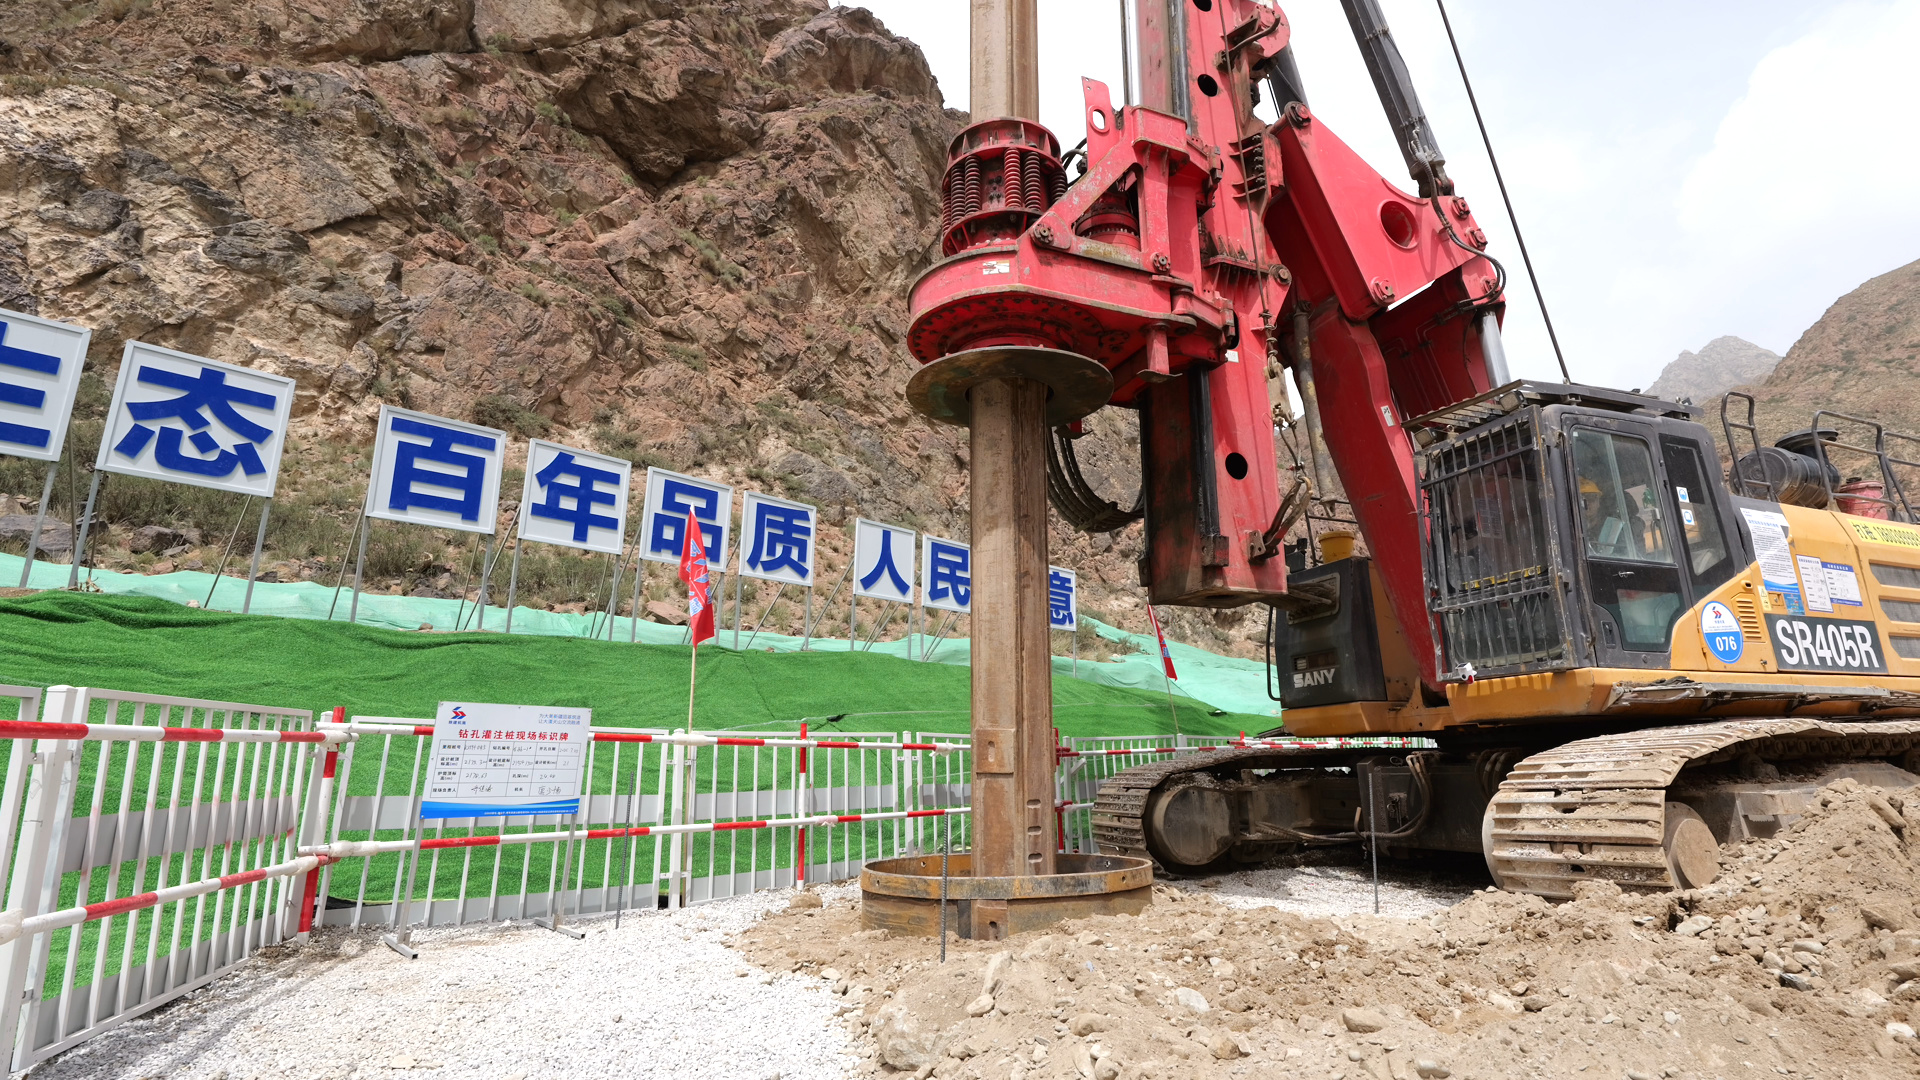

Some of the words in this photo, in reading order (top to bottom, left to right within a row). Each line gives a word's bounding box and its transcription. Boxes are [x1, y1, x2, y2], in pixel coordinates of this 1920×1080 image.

[388, 417, 811, 578] 百年品质
[860, 529, 1074, 625] 人民意
[1715, 635, 1737, 652] 076
[1776, 619, 1880, 668] SR405R
[1293, 668, 1336, 689] SANY
[458, 729, 569, 741] 钻孔灌注桩现场标识牌
